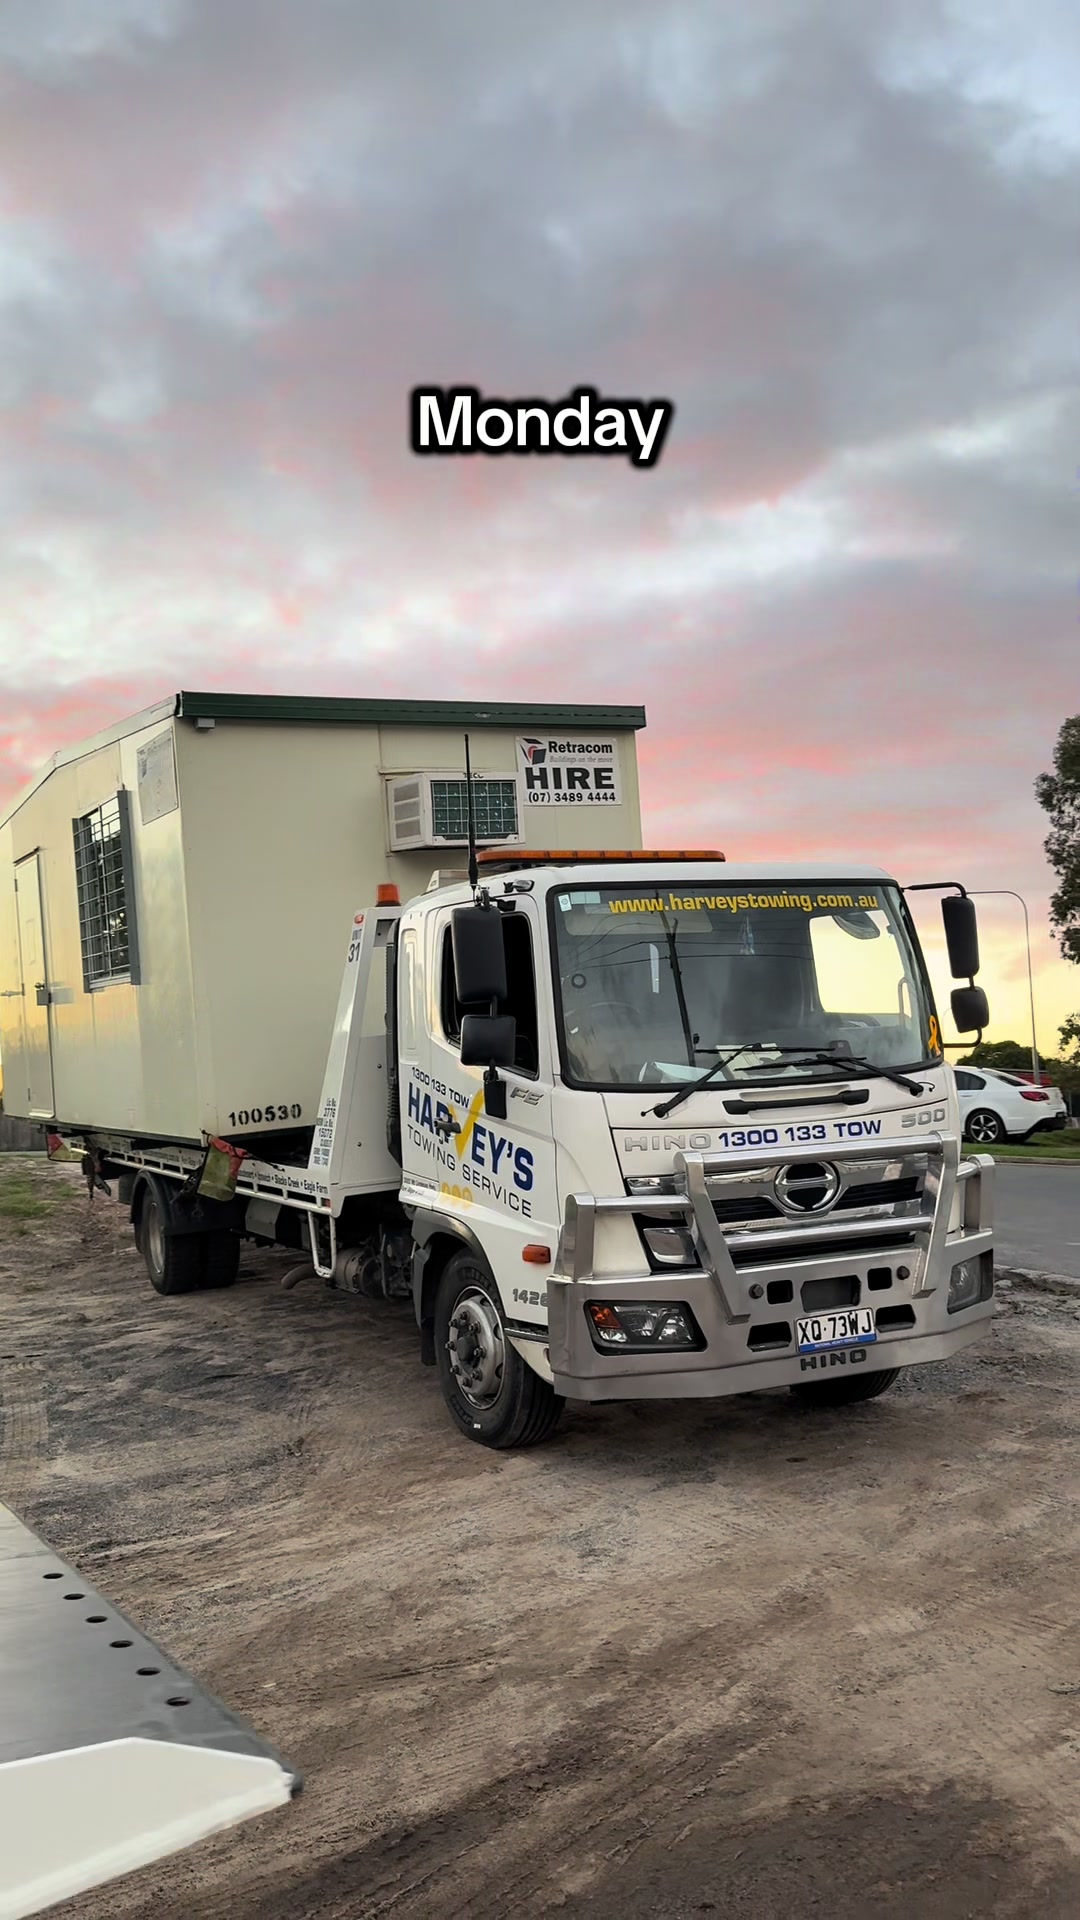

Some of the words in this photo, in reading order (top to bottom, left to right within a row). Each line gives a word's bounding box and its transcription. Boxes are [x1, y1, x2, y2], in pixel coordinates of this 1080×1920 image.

[548, 741, 613, 754] Retracom
[550, 755, 577, 764] Buildings
[525, 767, 615, 790] HIRE
[528, 791, 551, 803] (07)
[554, 792, 583, 802] 3489
[587, 792, 616, 802] 4444
[608, 891, 879, 914] www.harveystowing.com.au
[348, 942, 361, 963] 31
[412, 1067, 430, 1086] 1300
[431, 1078, 447, 1096] 133
[449, 1088, 470, 1109] TOW
[510, 1086, 544, 1106] FE
[228, 1103, 302, 1127] 100530
[901, 1108, 946, 1129] 500
[624, 1132, 712, 1152] HINO
[718, 1129, 778, 1148] 1300
[784, 1124, 827, 1143] 133
[833, 1119, 882, 1138] TOW
[407, 1124, 456, 1171] TOWING
[462, 1163, 532, 1218] SERVICE
[304, 1180, 316, 1193] Eagle
[316, 1182, 329, 1194] Farm
[801, 1349, 867, 1372] HINO
